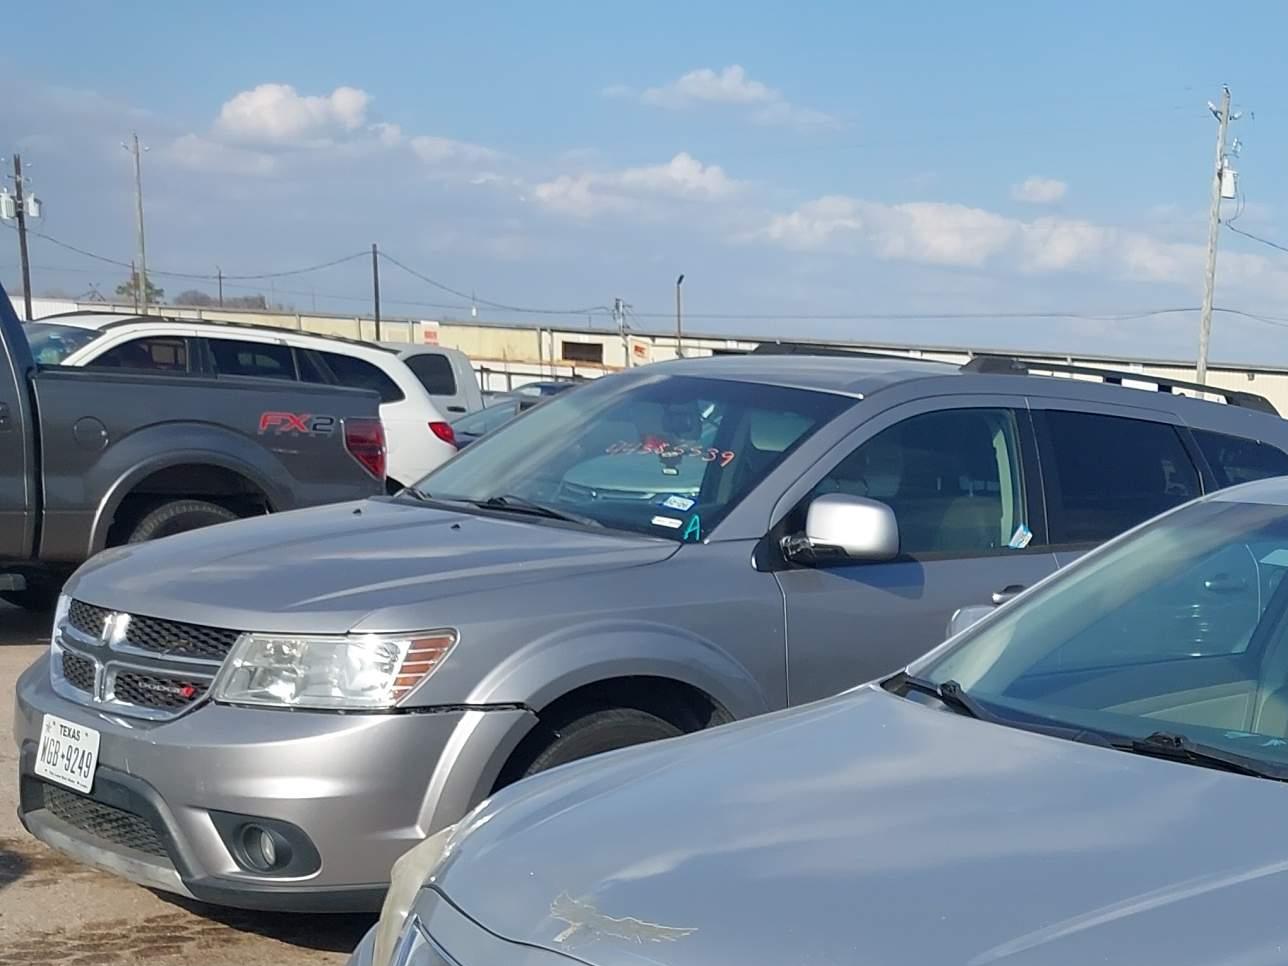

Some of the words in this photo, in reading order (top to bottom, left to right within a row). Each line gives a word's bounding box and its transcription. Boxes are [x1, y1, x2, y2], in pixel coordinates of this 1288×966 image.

[259, 411, 335, 433] FX2
[683, 514, 700, 541] A
[59, 724, 81, 742] TEXAS
